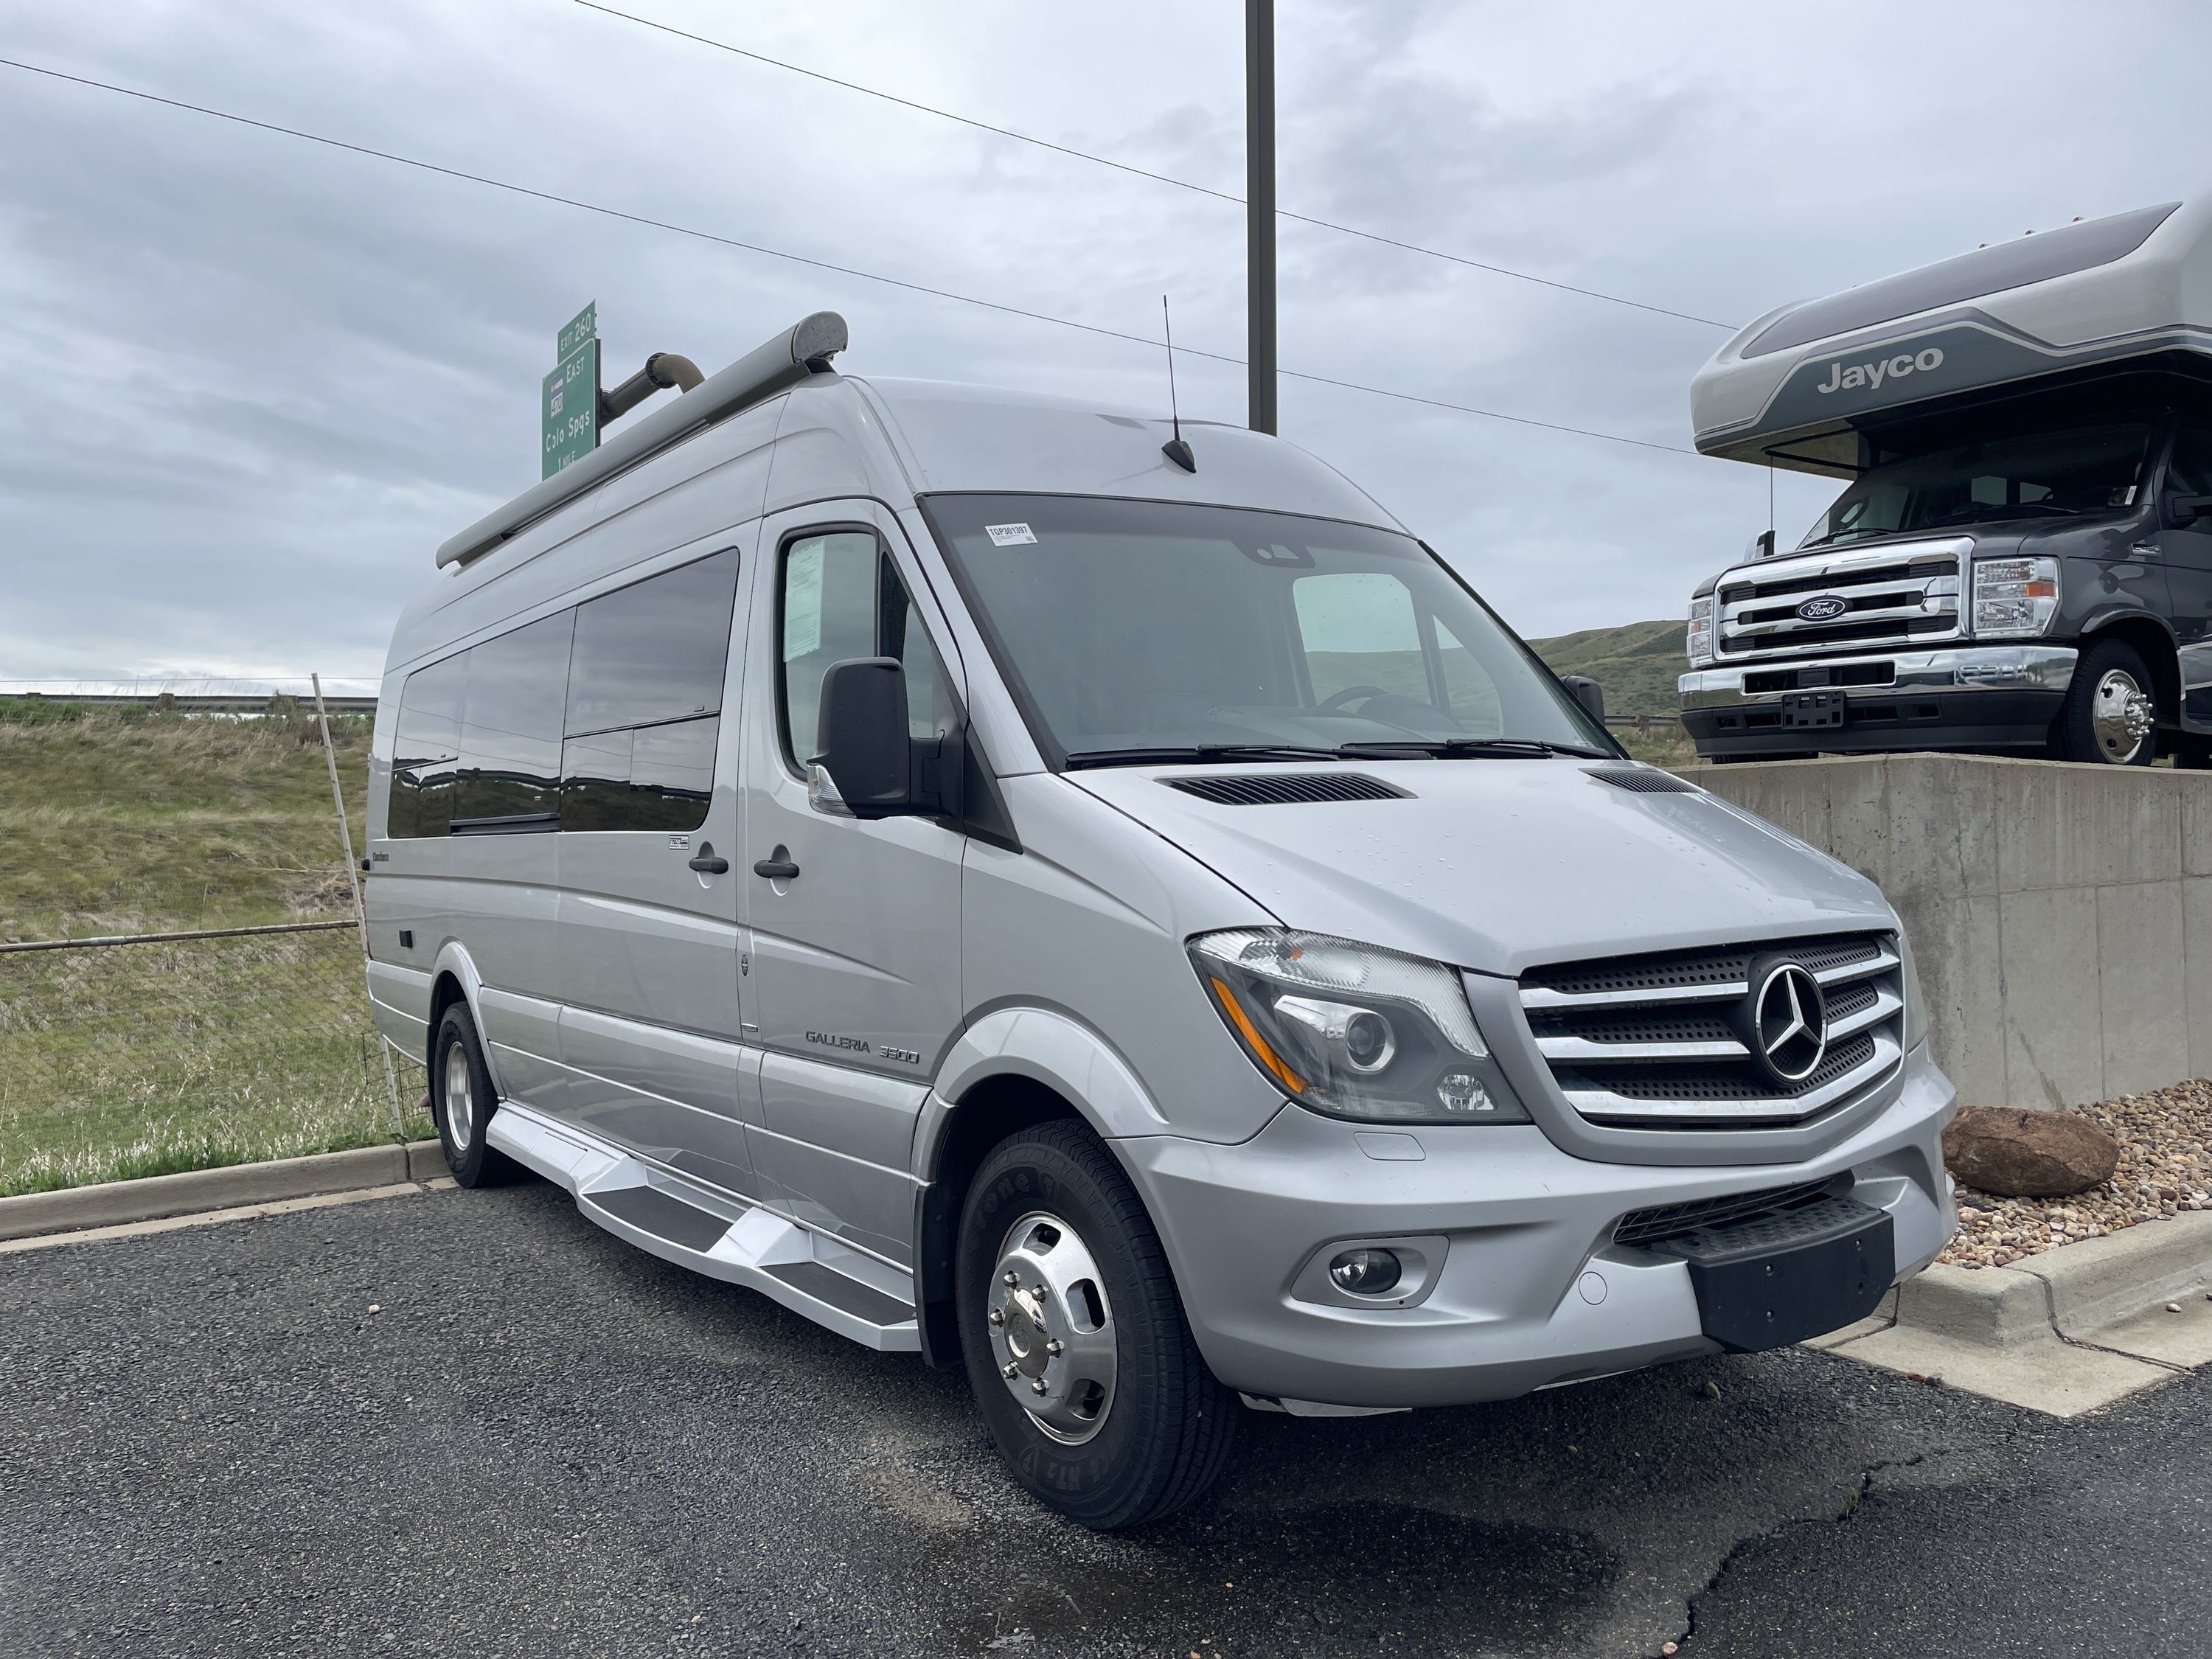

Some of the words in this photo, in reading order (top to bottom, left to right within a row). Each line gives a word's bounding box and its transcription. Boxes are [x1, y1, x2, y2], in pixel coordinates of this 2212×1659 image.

[561, 331, 573, 352] EXIT
[575, 313, 591, 343] 260
[566, 356, 585, 383] EAST
[1817, 347, 1944, 394] Jayco
[551, 395, 563, 414] 470
[546, 428, 564, 453] Colo
[568, 410, 590, 438] Spgs
[989, 526, 1028, 536] TGP301397
[1807, 602, 1836, 616] Ford
[805, 1031, 871, 1053] GALLERIA
[878, 1046, 919, 1064] 3500
